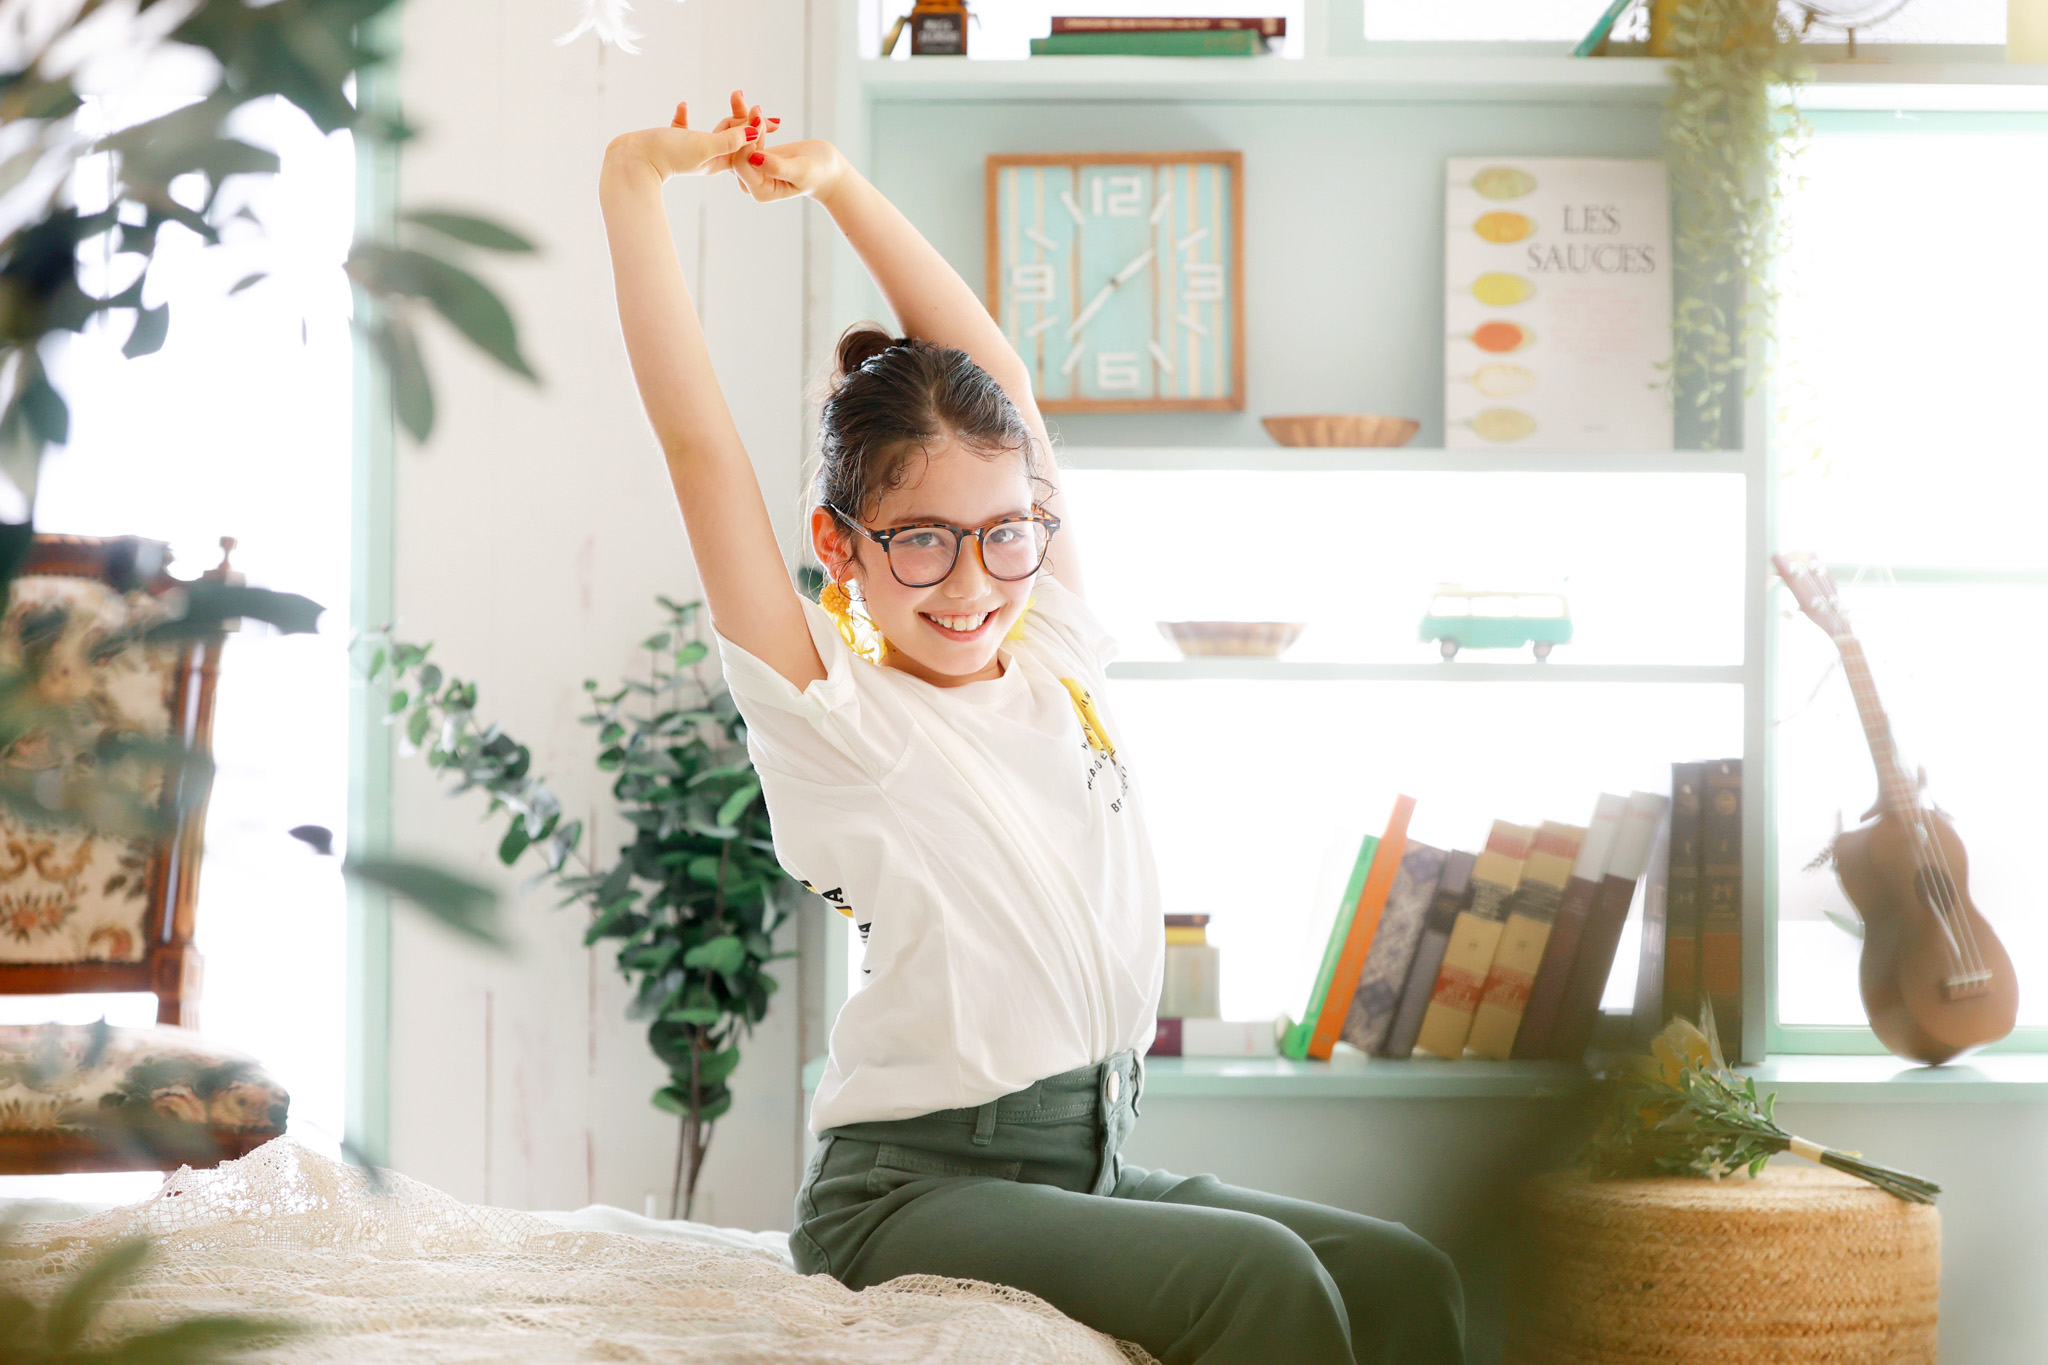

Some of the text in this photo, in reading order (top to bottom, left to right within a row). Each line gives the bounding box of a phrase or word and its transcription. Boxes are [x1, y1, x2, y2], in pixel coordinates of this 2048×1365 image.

[1091, 175, 1143, 217] 12
[1562, 204, 1622, 235] LES
[1526, 243, 1656, 274] SAUCES
[1011, 264, 1056, 302] 9
[1181, 262, 1225, 301] 3
[1096, 352, 1139, 390] 6
